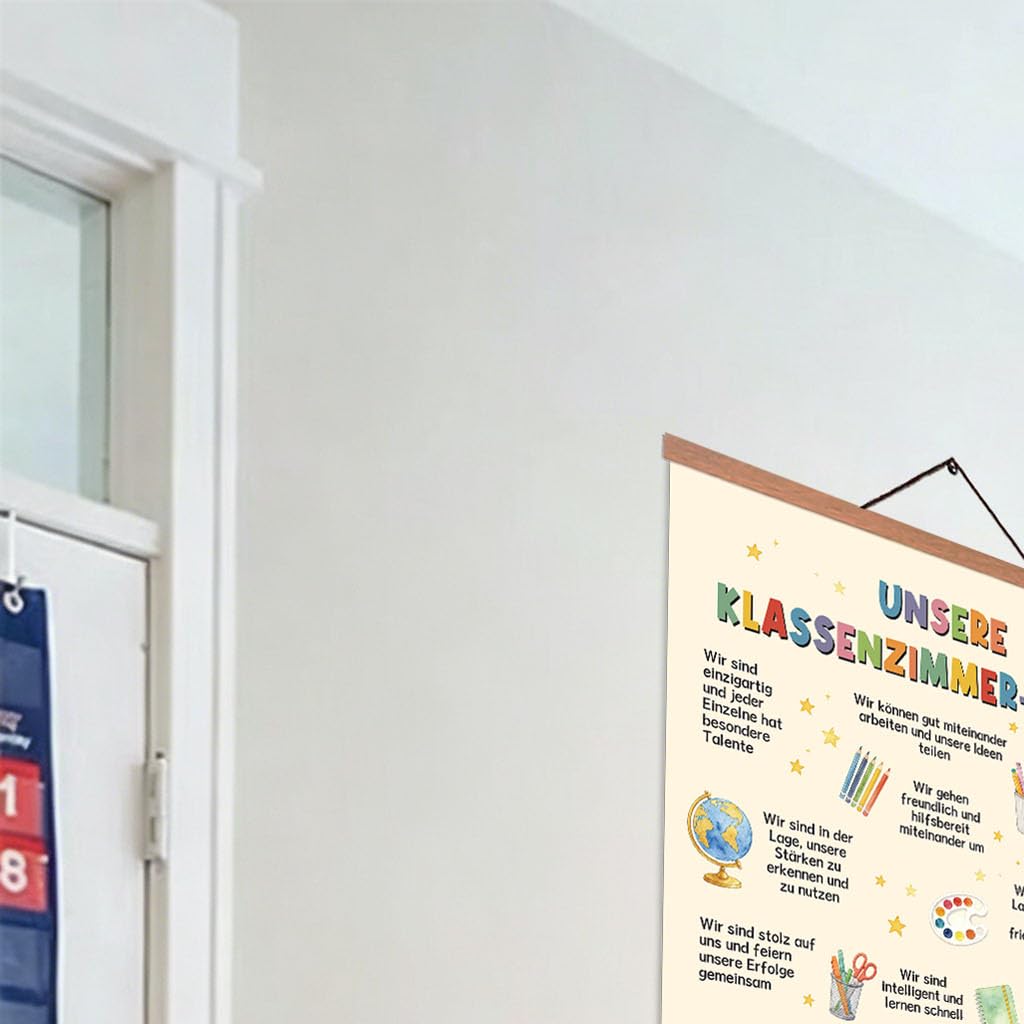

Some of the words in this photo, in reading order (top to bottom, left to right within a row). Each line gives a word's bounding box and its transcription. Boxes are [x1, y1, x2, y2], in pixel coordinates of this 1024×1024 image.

[879, 580, 1008, 658] UNSERE
[704, 648, 727, 666] Wir
[731, 659, 758, 676] sind
[703, 668, 772, 697] einzigartig
[703, 684, 726, 699] und
[730, 689, 764, 708] jeder
[703, 697, 757, 723] Einzelne
[761, 713, 782, 730] hat
[854, 693, 874, 709] Wir
[878, 700, 919, 722] können
[922, 716, 940, 729] gut
[944, 722, 1007, 747] miteinander
[703, 713, 770, 742] besondere
[859, 713, 908, 734] arbeiten
[911, 728, 931, 741] und
[935, 734, 971, 752] unsere
[974, 743, 1003, 761] Ideen
[703, 730, 754, 754] Talente
[919, 742, 950, 760] teilen
[901, 793, 958, 817] freundlich
[961, 811, 980, 823] und
[763, 811, 785, 827] Wir
[789, 820, 815, 835] sind
[819, 825, 830, 838] in
[833, 830, 853, 843] der
[912, 810, 970, 835] hilfsbereit
[807, 841, 846, 858] unsere
[900, 825, 965, 848] miteinander
[969, 842, 984, 853] um
[775, 846, 824, 868] Stärken
[827, 861, 841, 872] zu
[767, 863, 823, 884] erkennen
[827, 877, 849, 889] und
[780, 882, 794, 894] zu
[798, 886, 840, 903] nutzen
[700, 916, 723, 932] Wir
[728, 924, 754, 939] sind
[758, 930, 790, 946] stolz
[794, 938, 815, 951] auf
[699, 936, 721, 949] uns
[726, 941, 749, 954] und
[753, 943, 792, 961] feiern
[699, 953, 743, 969] unsere
[747, 958, 794, 979] Erfolge
[900, 968, 920, 982] Wir
[924, 974, 947, 988] sind
[699, 969, 771, 990] gemeinsam
[885, 996, 921, 1013] lernen
[924, 1005, 963, 1020] schnell
[943, 994, 963, 1005] und
